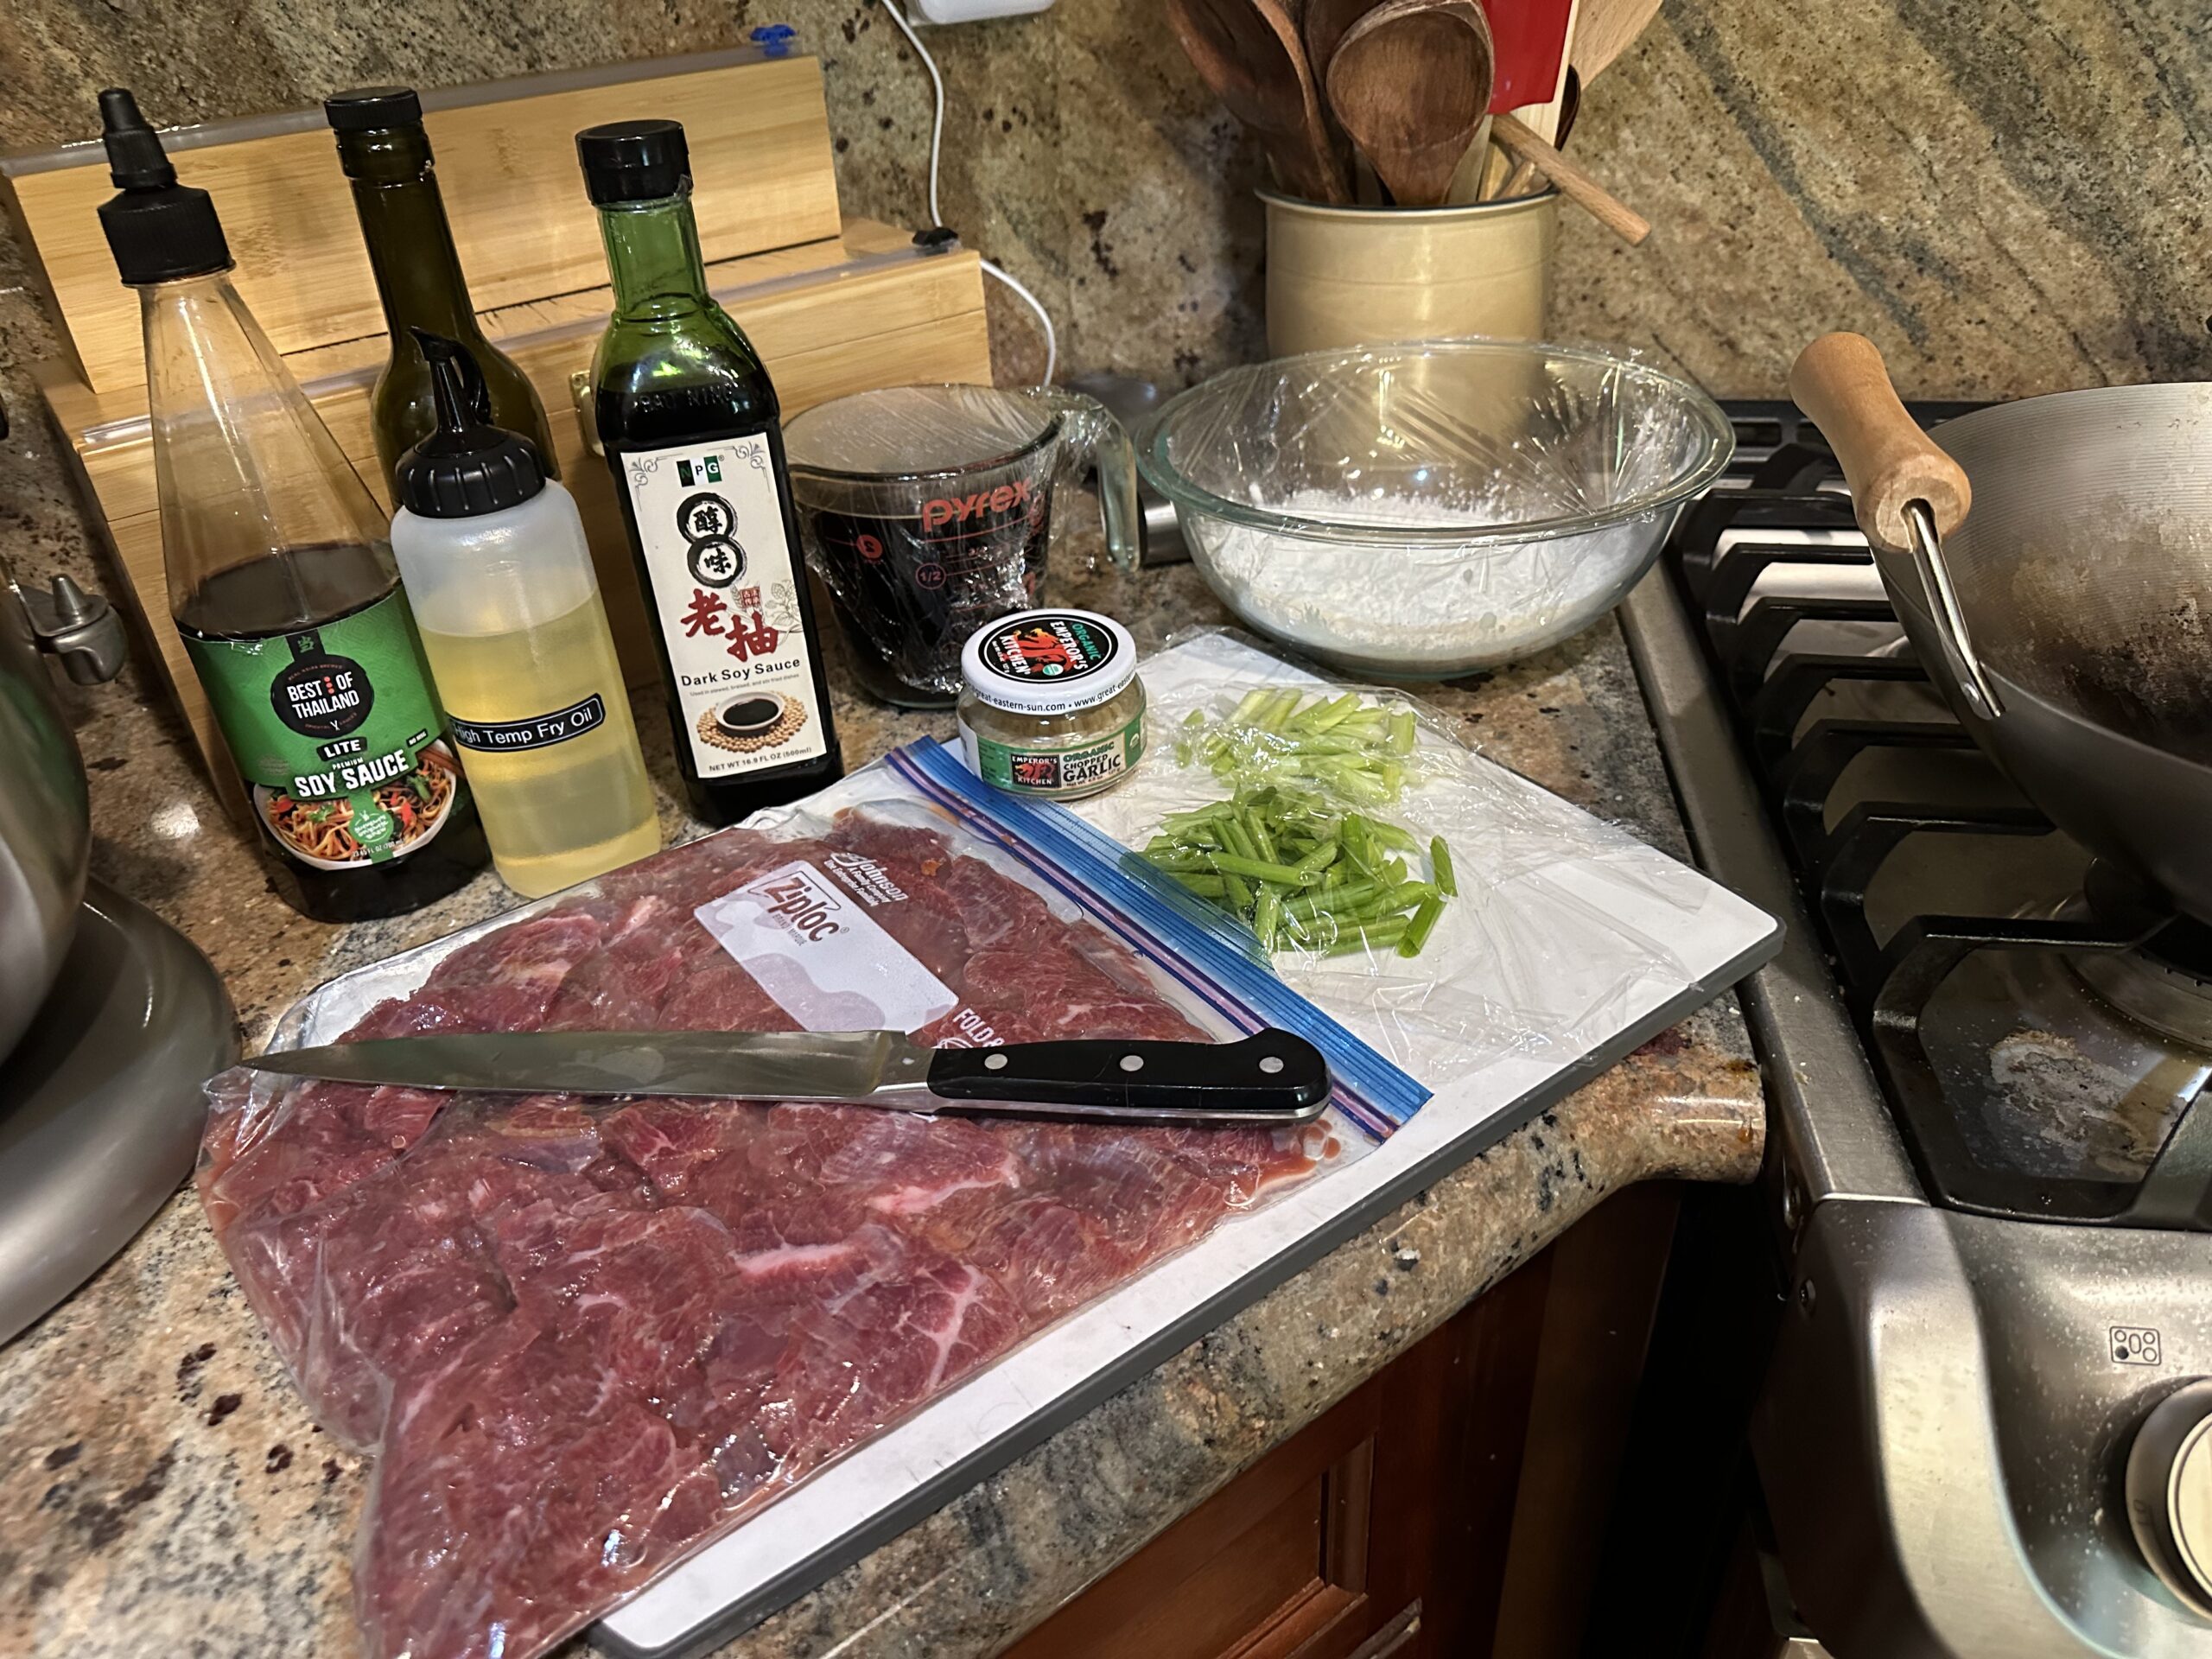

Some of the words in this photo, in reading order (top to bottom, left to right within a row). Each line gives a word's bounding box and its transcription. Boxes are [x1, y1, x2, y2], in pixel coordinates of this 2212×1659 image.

[680, 461, 720, 478] NPG
[922, 479, 1032, 532] pyrex
[920, 571, 942, 582] 1/2
[681, 588, 779, 662] 老抽
[1000, 635, 1030, 674] KITCHEN
[1050, 621, 1088, 670] EMPEROR'S
[1072, 623, 1101, 660] ORGANIC
[287, 680, 323, 702] BEST
[335, 671, 353, 690] OF
[681, 672, 718, 686] Dark
[721, 668, 750, 681] Soy
[755, 658, 801, 675] Sauce
[292, 690, 360, 719] THAILAND
[454, 724, 481, 744] High
[482, 729, 532, 744] Temp
[537, 721, 565, 738] Fry
[570, 708, 593, 727] Oil
[324, 740, 361, 758] LITE
[332, 757, 364, 770] PREMIUM
[741, 757, 759, 766] 16.9
[770, 752, 782, 760] OZ
[783, 747, 812, 759] (500ml)
[1012, 755, 1058, 765] EMPEROR'S
[1063, 741, 1115, 762] ORGANIC
[1064, 753, 1108, 770] CHOPPED
[295, 772, 337, 797] SOY
[341, 749, 410, 790] SAUCE
[1064, 754, 1121, 782] GARLIC
[830, 853, 909, 901] Johnson
[765, 876, 840, 942] Ziploc
[952, 1007, 995, 1043] FOLD
